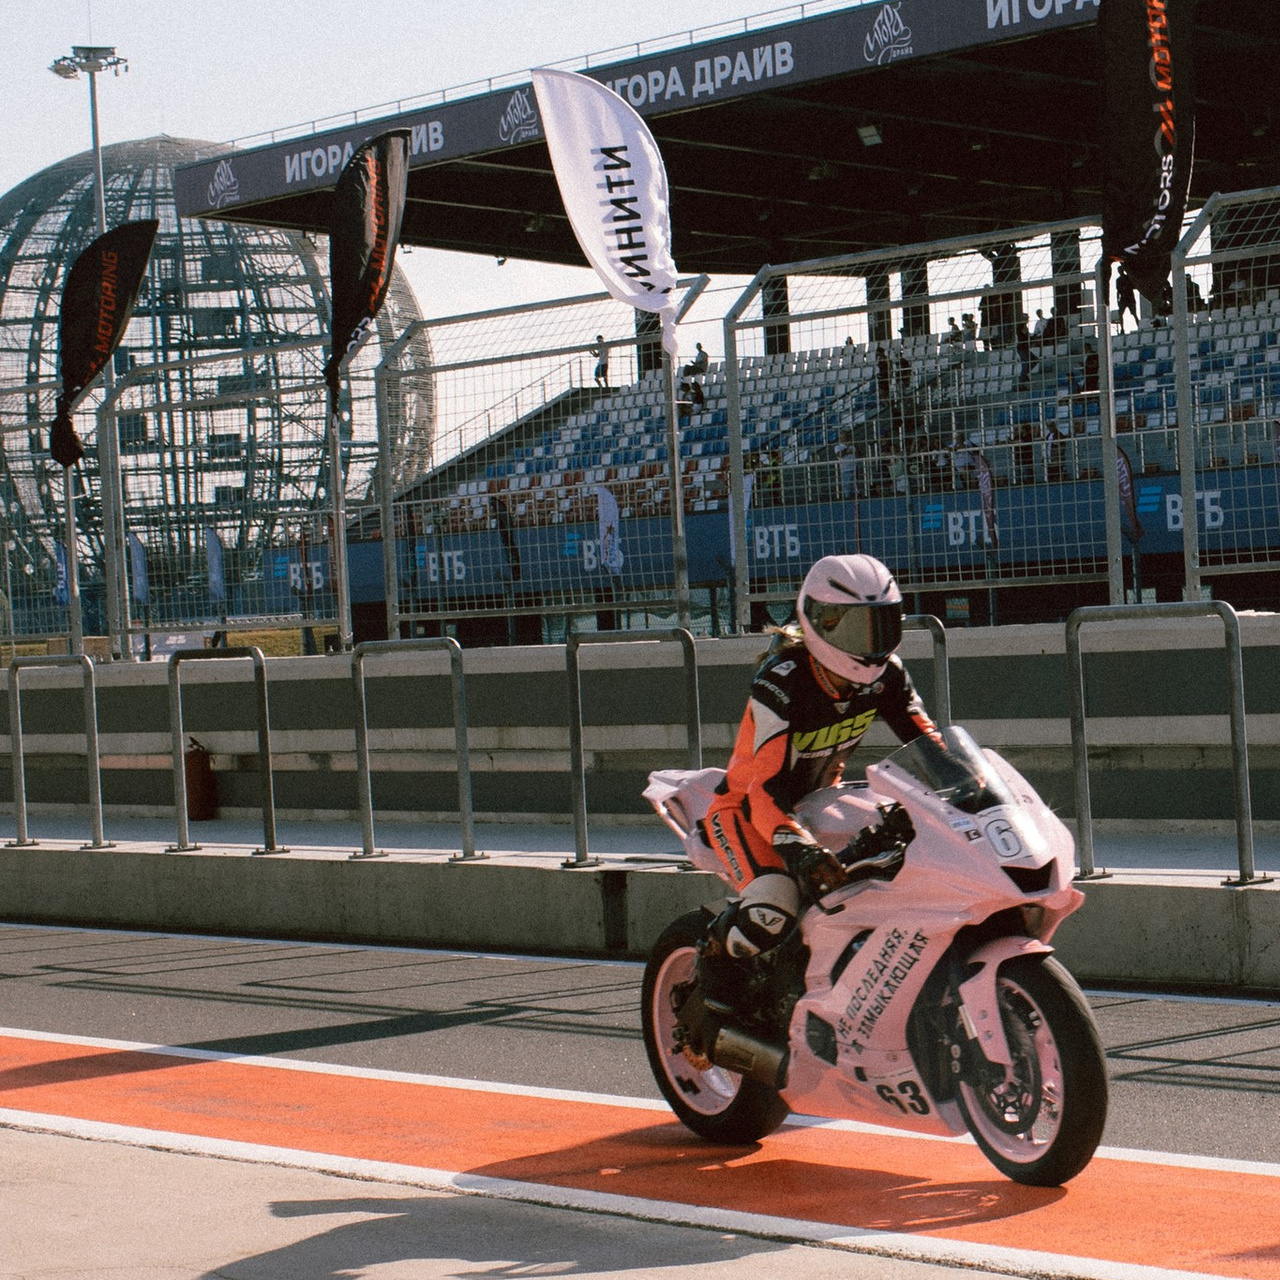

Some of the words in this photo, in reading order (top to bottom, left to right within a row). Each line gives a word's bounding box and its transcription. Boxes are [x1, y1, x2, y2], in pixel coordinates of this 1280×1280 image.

[692, 41, 795, 98] ДРАЙВ
[95, 250, 118, 354] MOTORING
[756, 523, 802, 559] ВТБ
[288, 561, 324, 591] ВТБ
[427, 550, 467, 583] ВТБ
[837, 1017, 853, 1039] НЕ
[876, 1080, 931, 1116] 63
